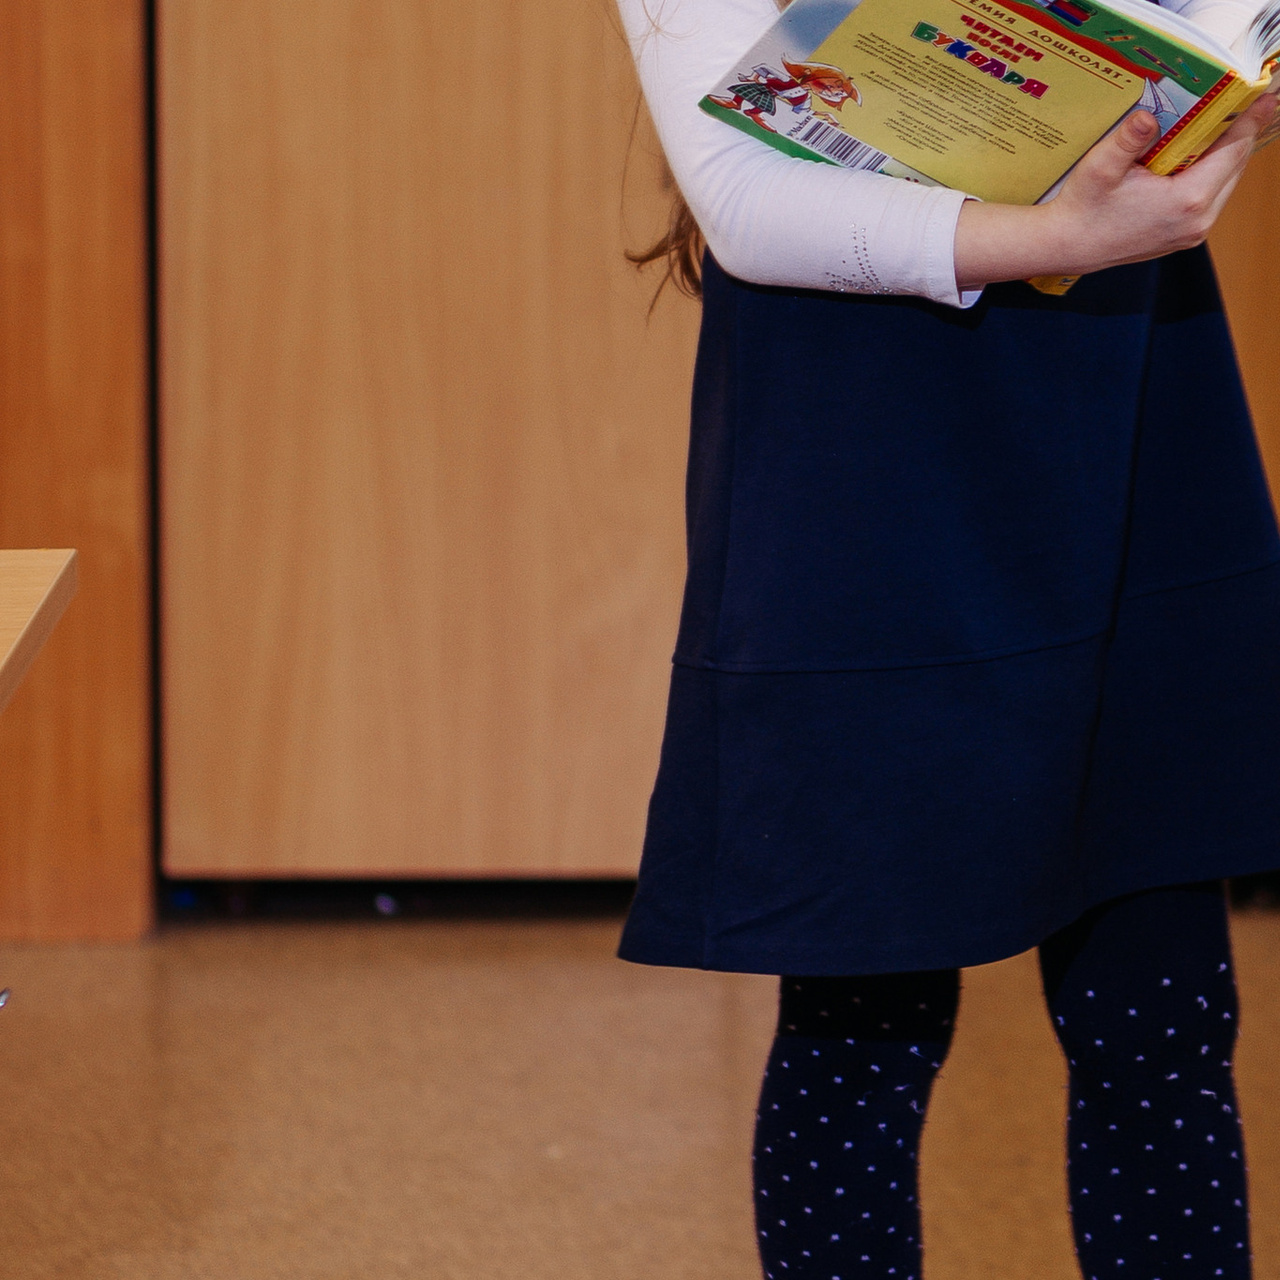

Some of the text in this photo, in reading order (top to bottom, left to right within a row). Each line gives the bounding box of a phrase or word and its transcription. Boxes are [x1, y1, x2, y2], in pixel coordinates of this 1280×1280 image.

[909, 20, 1051, 100] БУКВАРЯ
[959, 14, 1044, 63] ЧИТАЕМ
[966, 32, 1021, 64] ПОСЛЕ
[1027, 28, 1124, 80] ДОШКОЛЯТ
